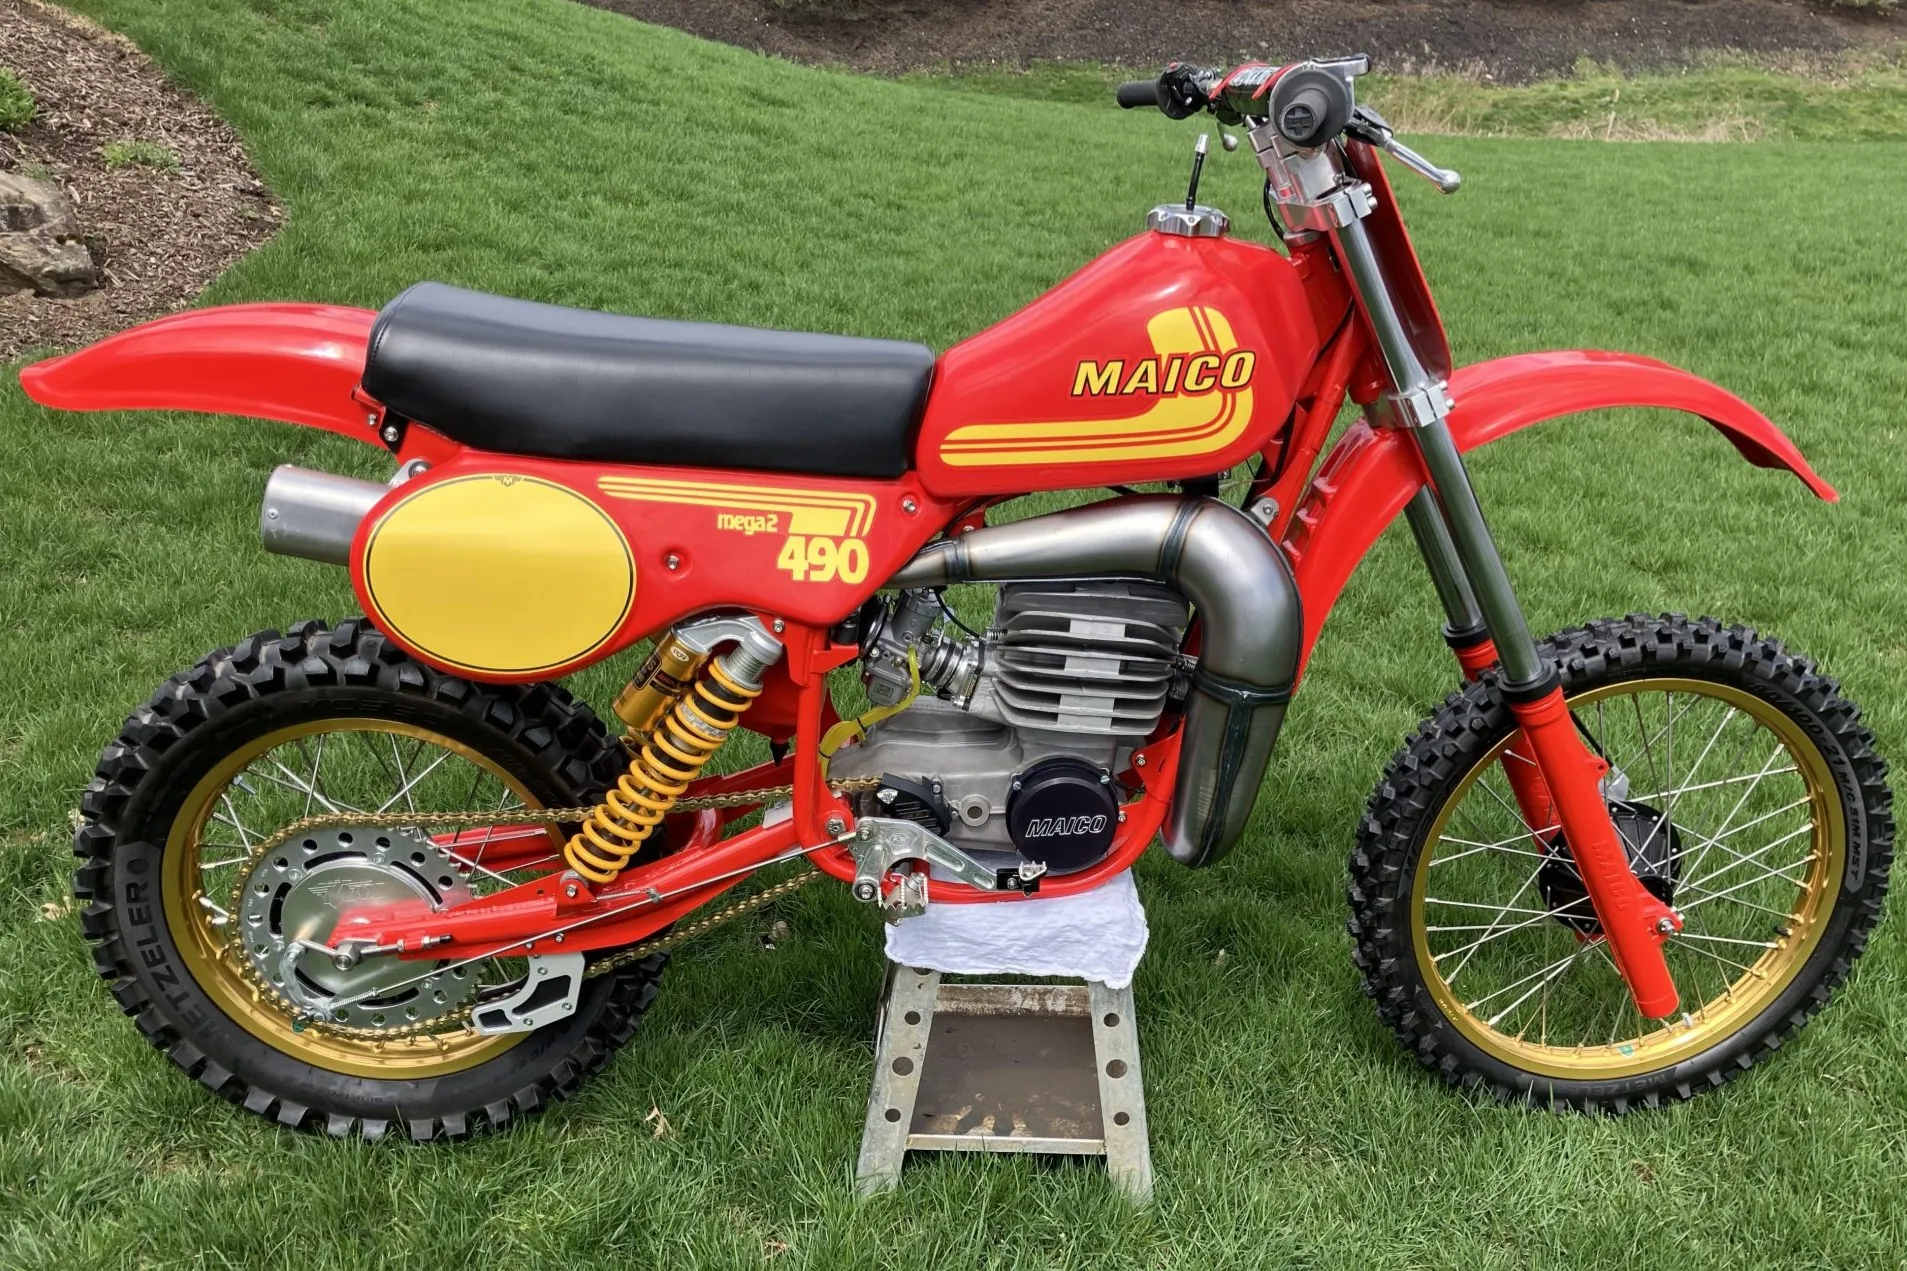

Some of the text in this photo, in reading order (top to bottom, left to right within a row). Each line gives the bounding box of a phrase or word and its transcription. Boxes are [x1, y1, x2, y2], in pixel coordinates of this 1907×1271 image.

[1070, 350, 1257, 398] MAICO
[717, 512, 778, 536] mega2
[777, 536, 870, 584] 490
[1838, 770, 1856, 803] M/C
[1026, 815, 1107, 837] MAICO
[1849, 807, 1862, 838] 51M
[1849, 841, 1862, 881] MST
[126, 882, 220, 1045] METZELER
